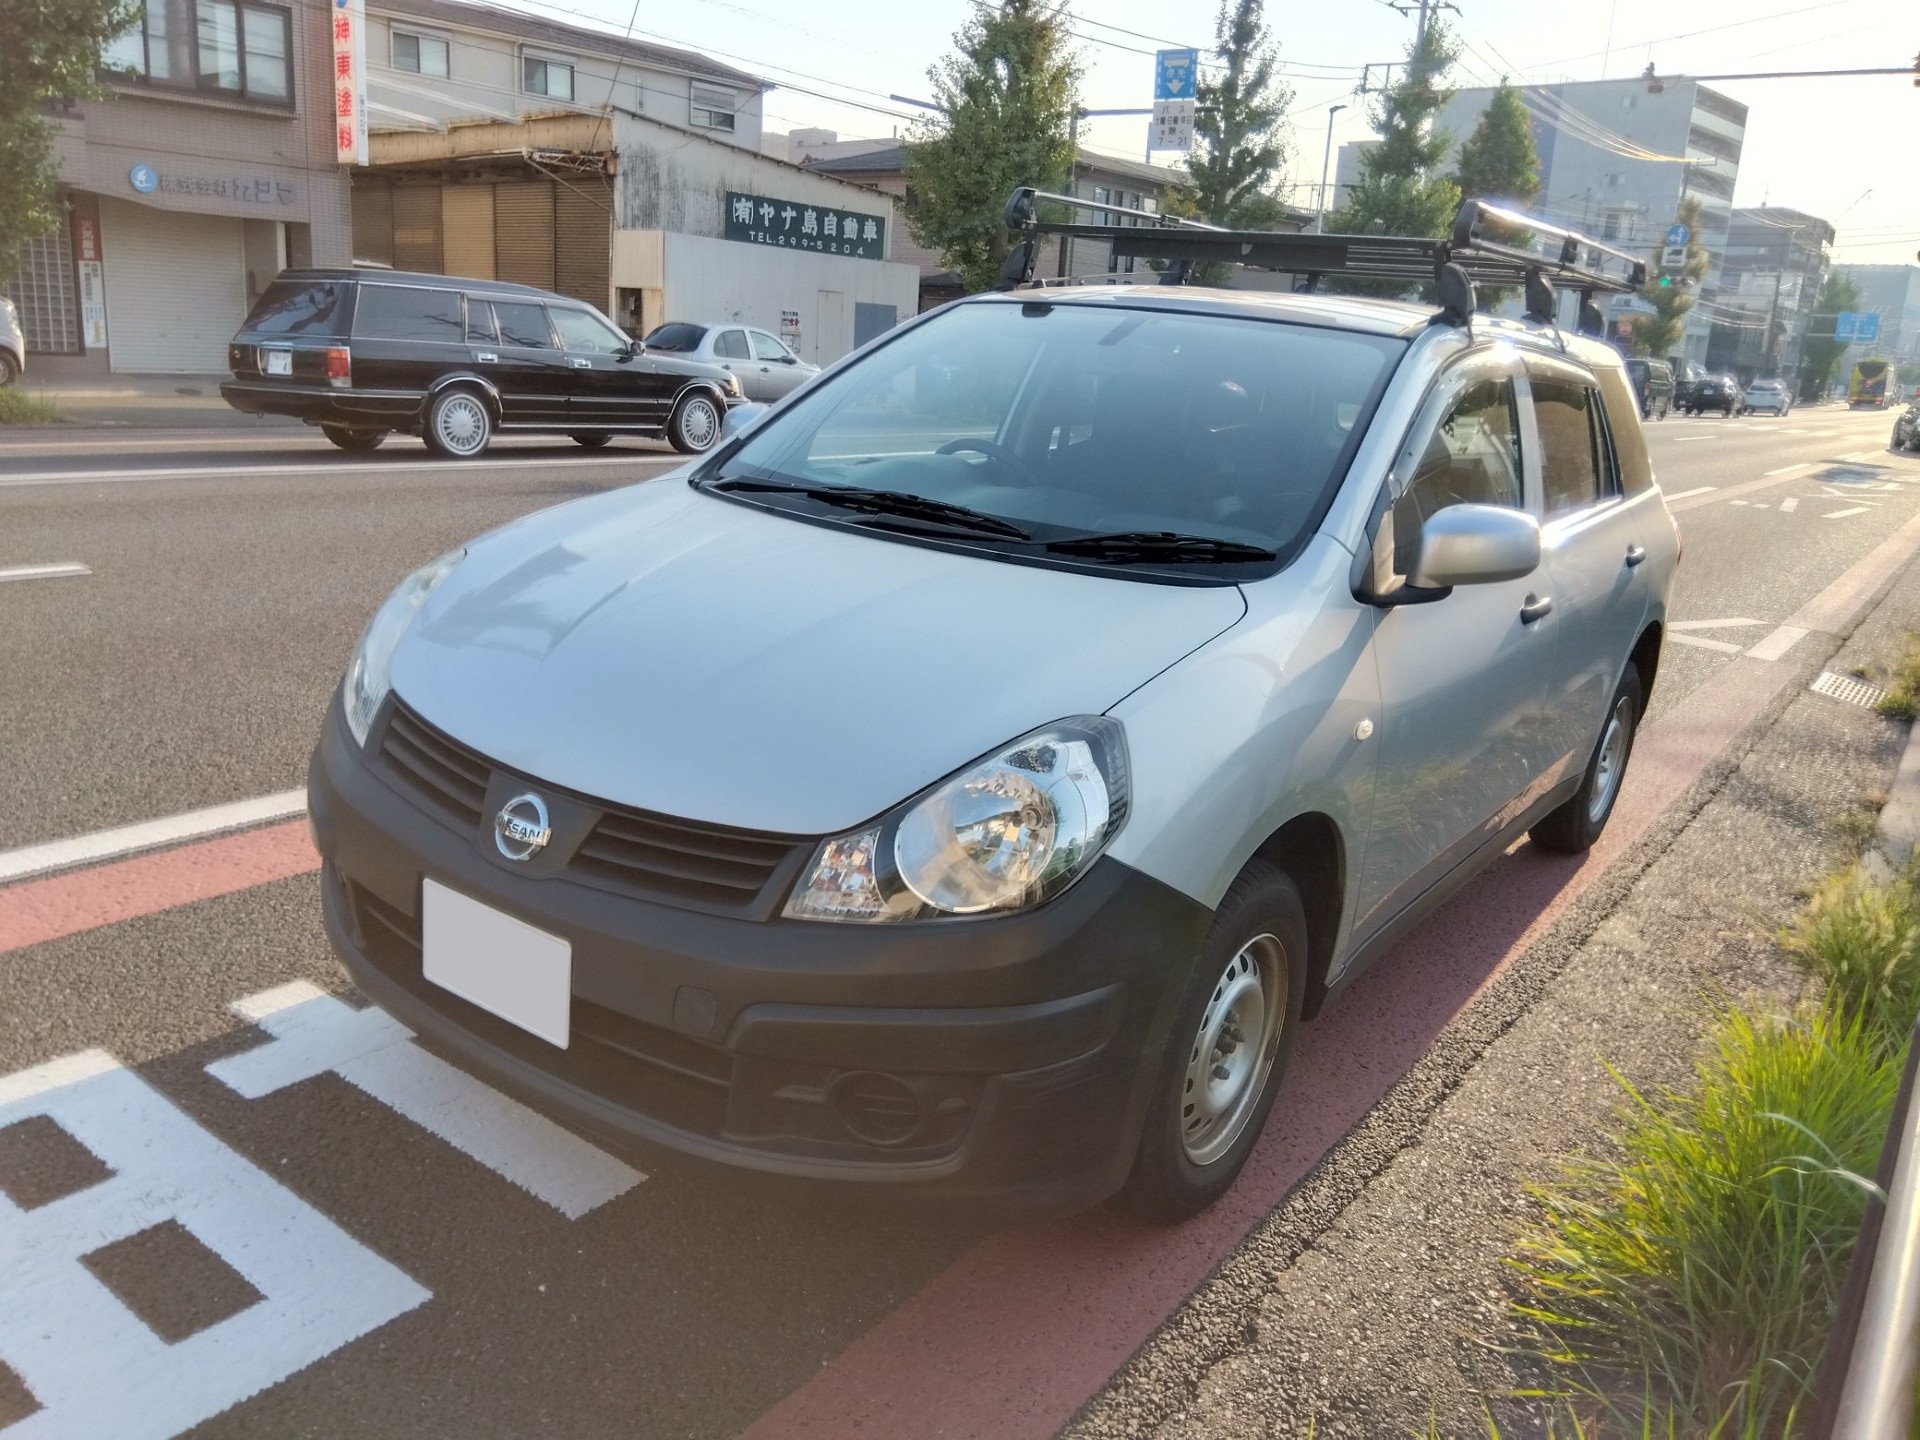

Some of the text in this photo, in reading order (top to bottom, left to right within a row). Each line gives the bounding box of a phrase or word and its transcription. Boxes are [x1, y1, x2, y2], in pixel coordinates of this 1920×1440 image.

[334, 14, 353, 152] 神東塗料
[1161, 105, 1186, 115] バス
